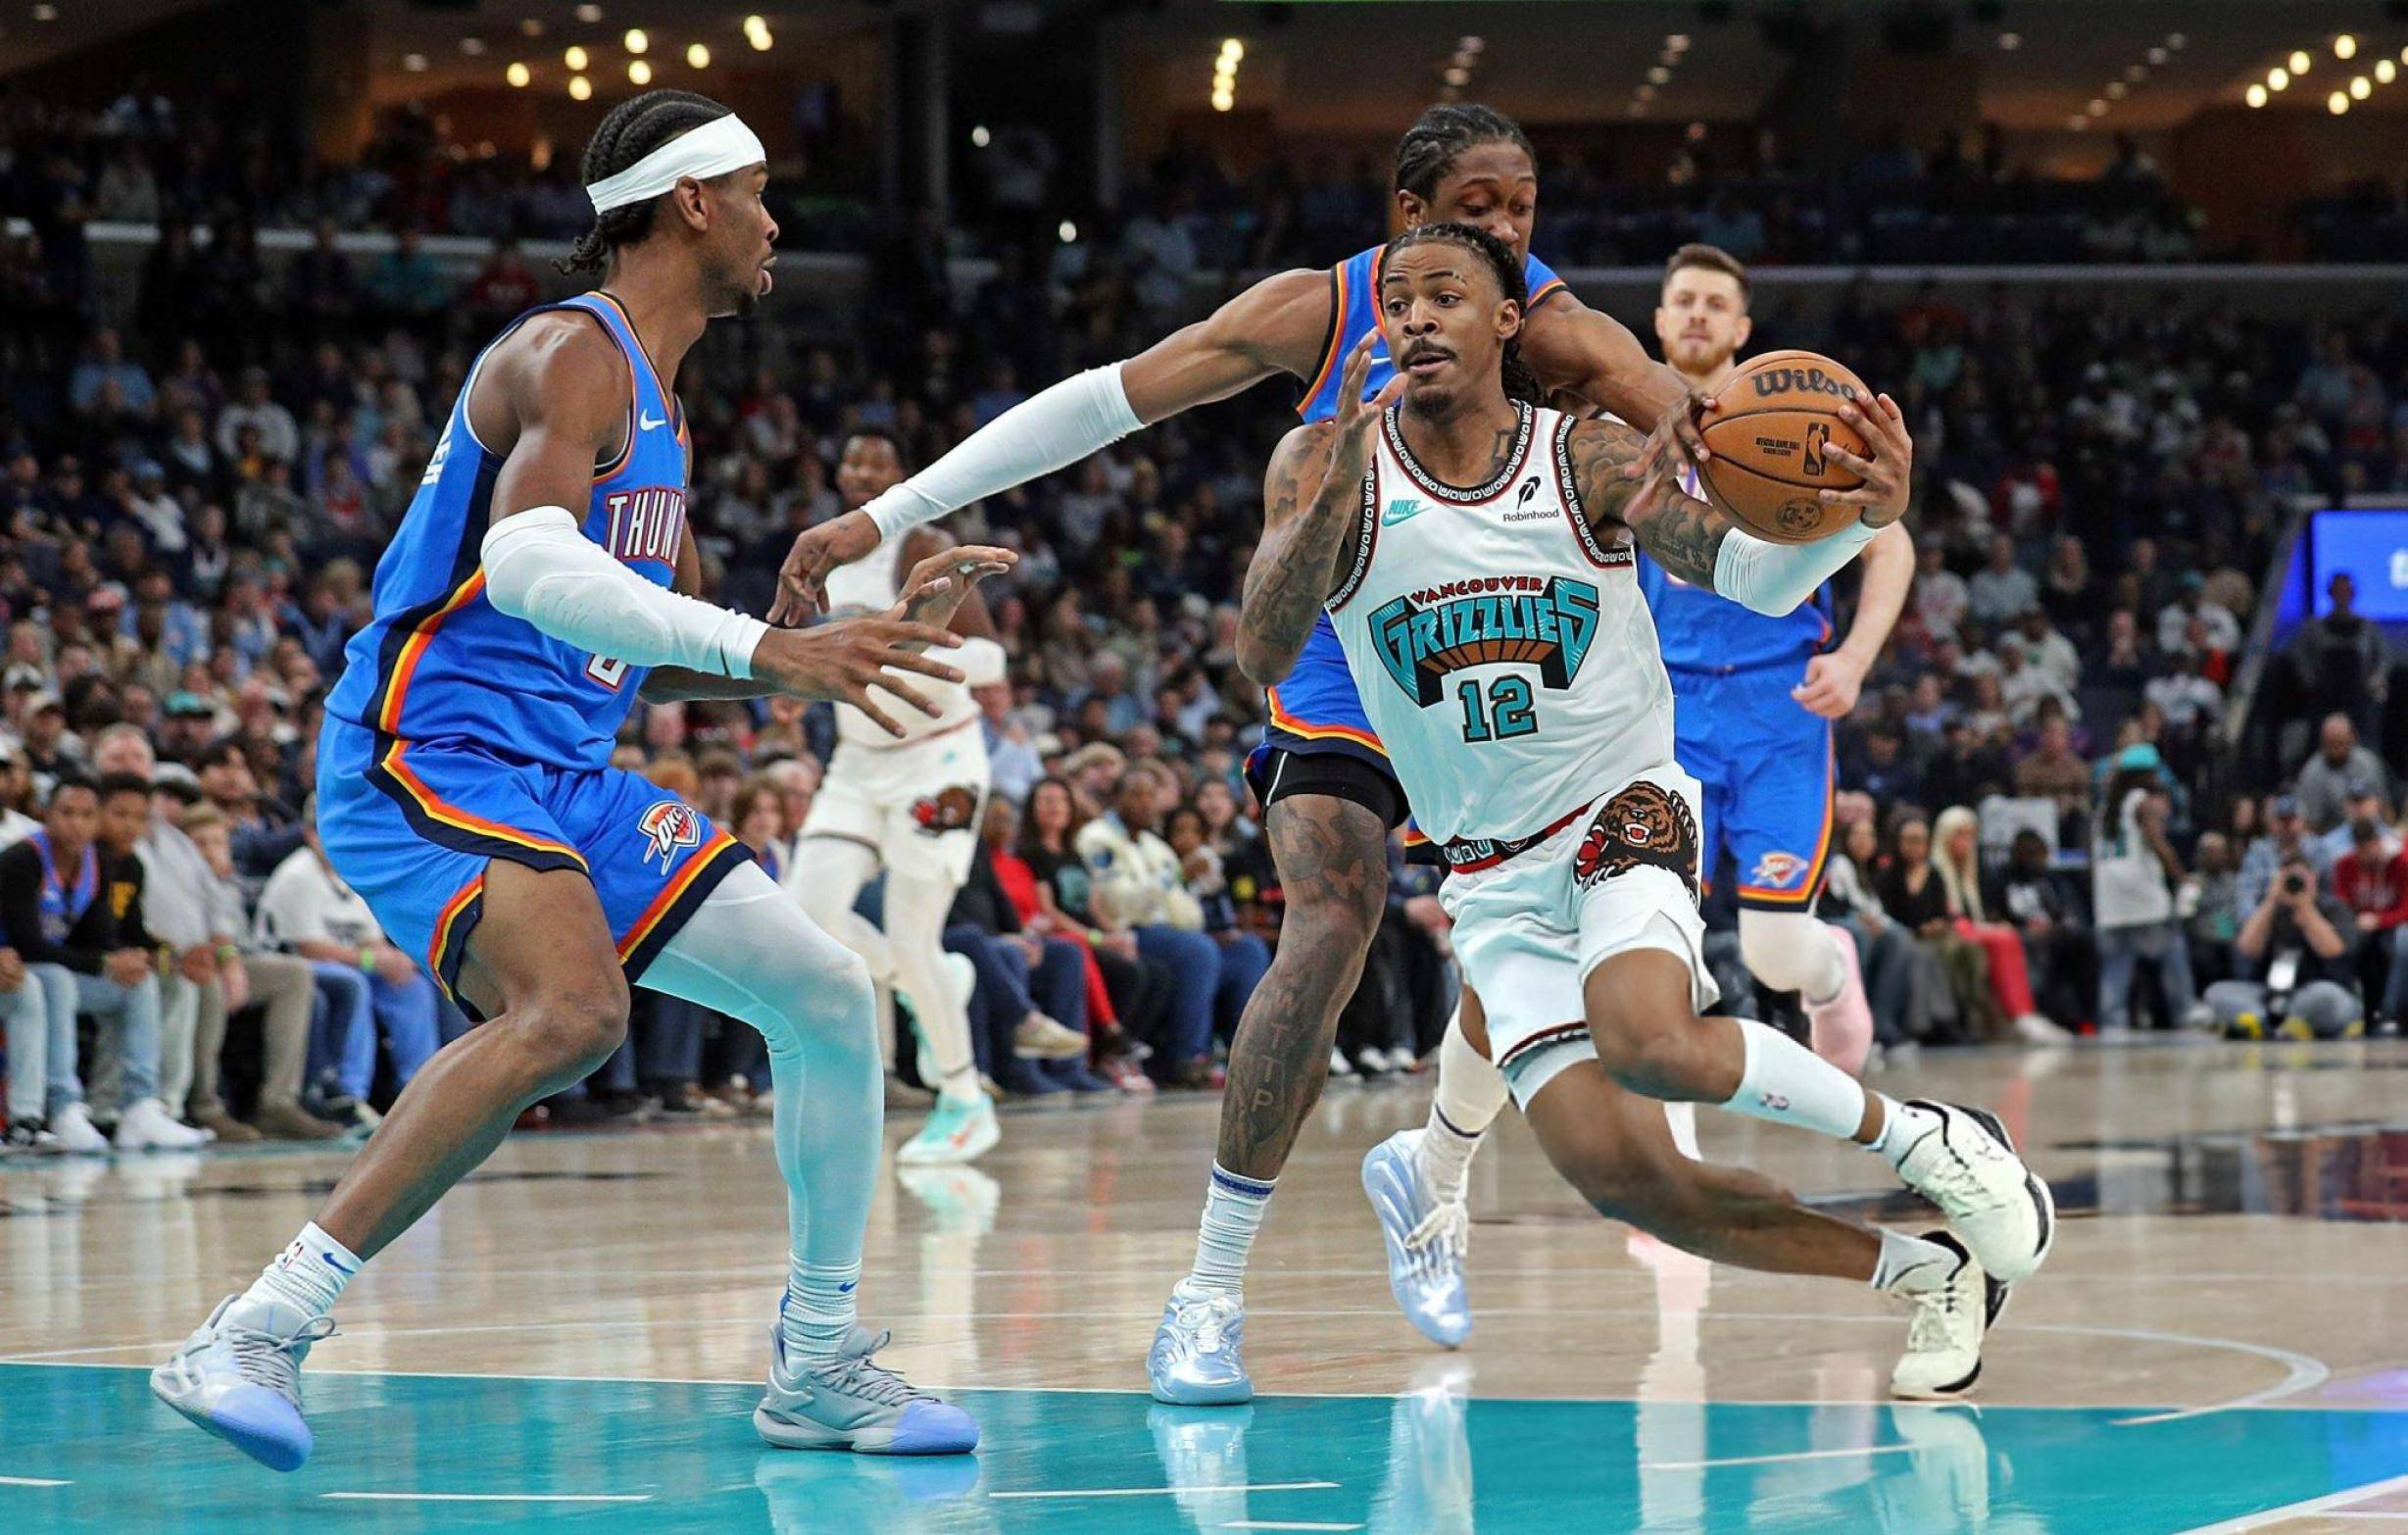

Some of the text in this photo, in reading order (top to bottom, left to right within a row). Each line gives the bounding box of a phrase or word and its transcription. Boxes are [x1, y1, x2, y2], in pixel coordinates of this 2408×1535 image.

[1751, 368, 1857, 402] Wilso
[1388, 499, 1421, 516] NIKE
[1502, 508, 1560, 522] Robinhood
[1411, 575, 1544, 605] VANCOUVER
[1367, 575, 1601, 708] GRIZZLIES
[1457, 673, 1539, 743] 12
